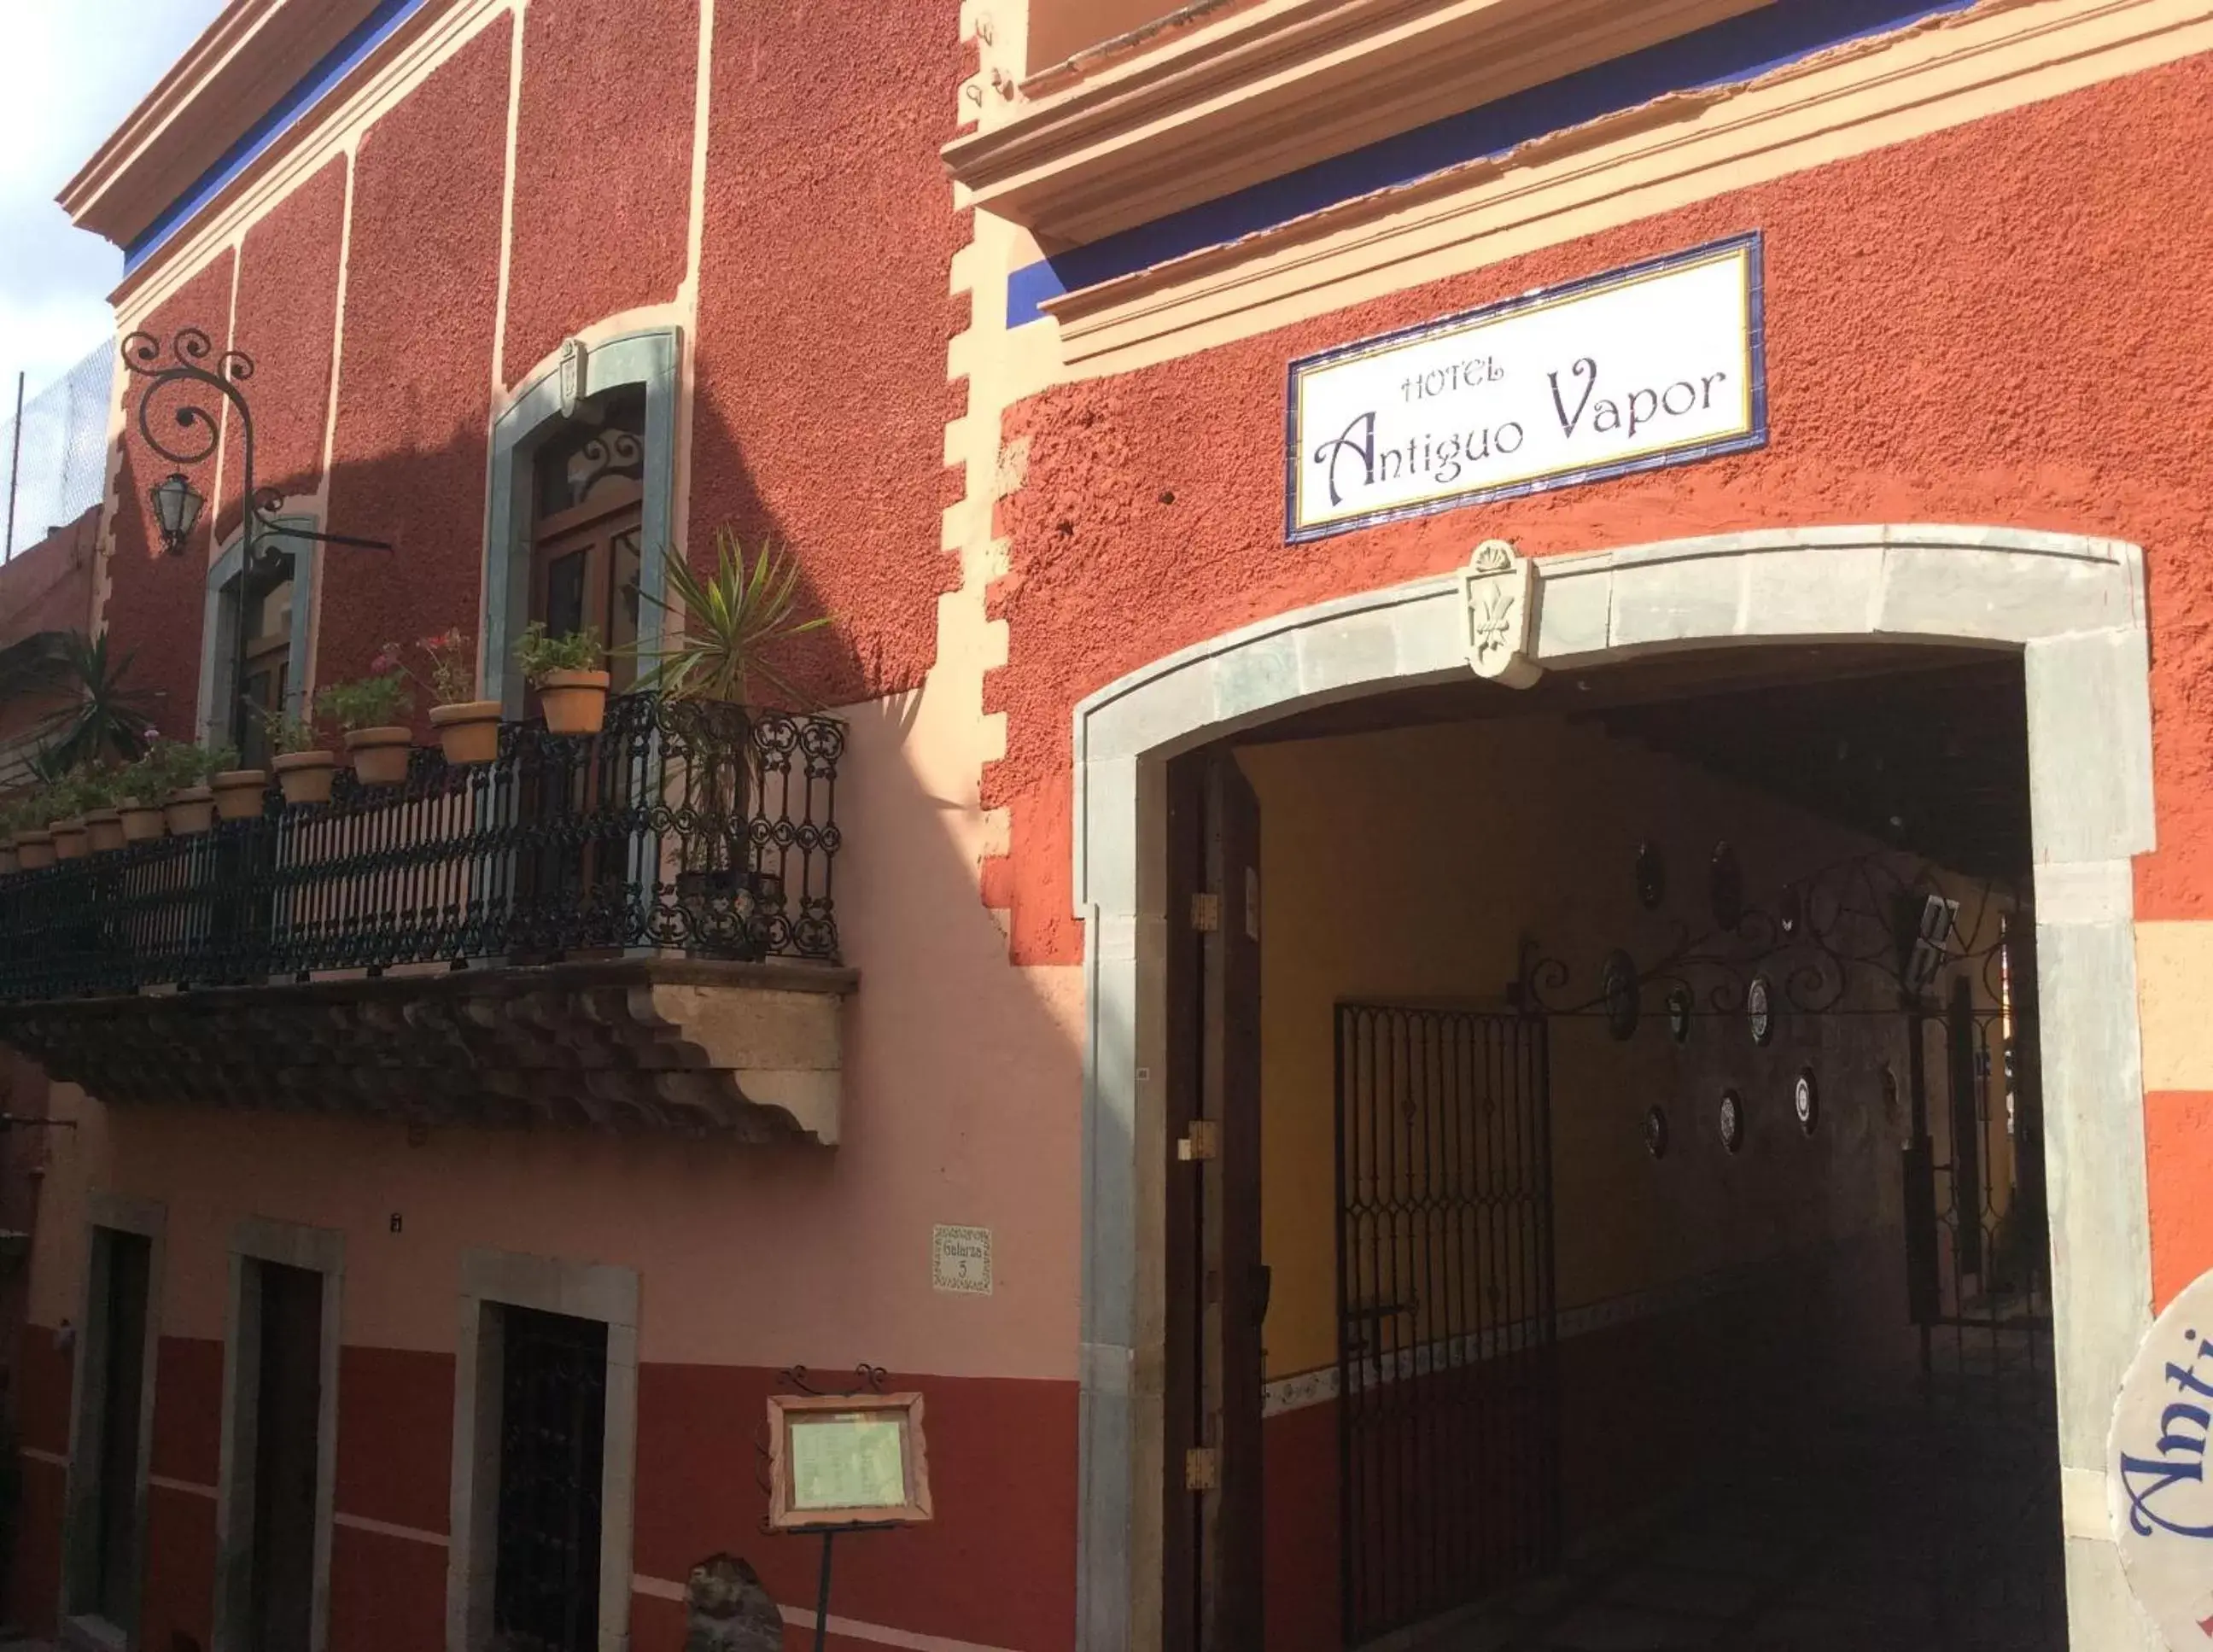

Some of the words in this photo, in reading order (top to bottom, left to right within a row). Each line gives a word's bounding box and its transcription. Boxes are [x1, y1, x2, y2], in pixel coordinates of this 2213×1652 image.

[1401, 355, 1504, 401] HOTEL
[1314, 411, 1524, 507] Antiguo
[1547, 357, 1726, 439] Vapor
